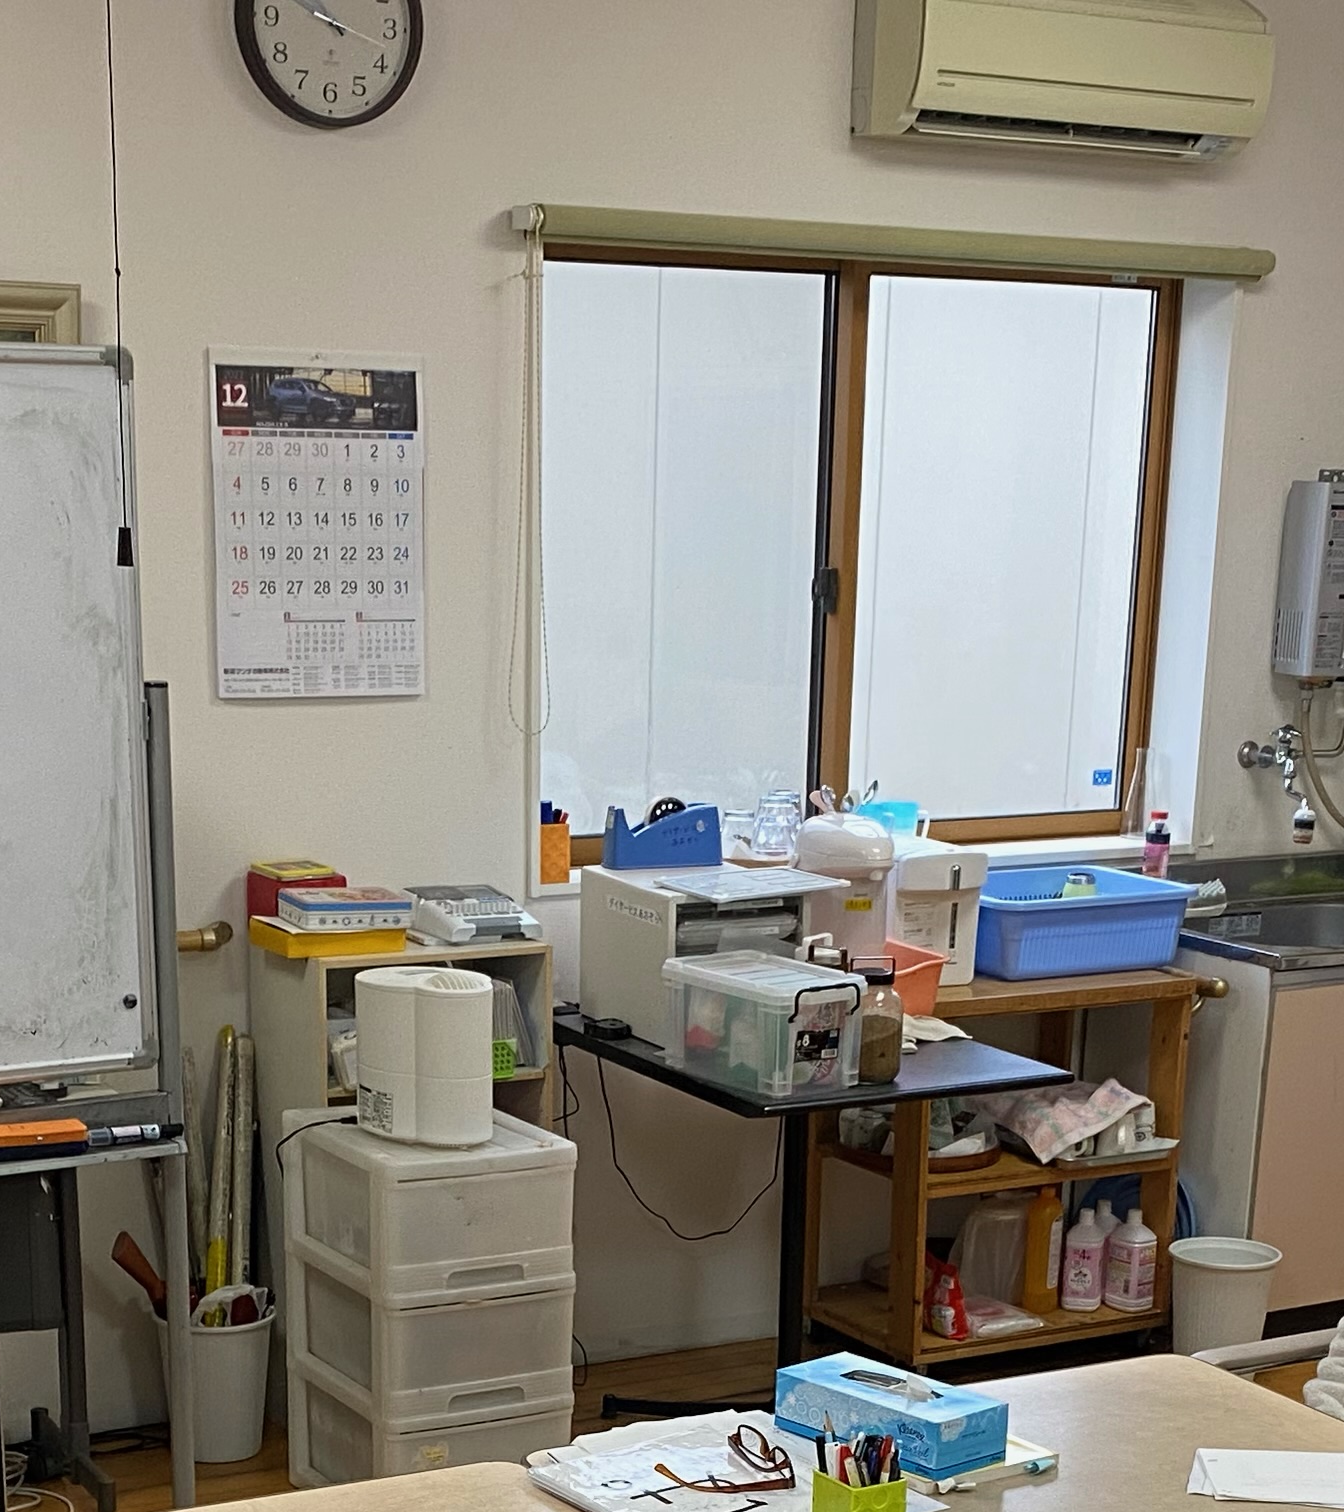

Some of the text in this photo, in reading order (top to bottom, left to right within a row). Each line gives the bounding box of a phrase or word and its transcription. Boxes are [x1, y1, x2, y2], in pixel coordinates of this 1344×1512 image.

[264, 5, 279, 27] 9
[383, 18, 397, 40] 3
[272, 41, 288, 64] 8
[373, 53, 388, 74] 4
[294, 69, 309, 90] 7
[352, 75, 367, 97] 5
[323, 82, 338, 103] 6
[222, 383, 249, 407] 12
[227, 441, 405, 459] 27 28 29 30 1 2 3
[233, 476, 409, 493] 4 5 6 7 8 9 10
[231, 511, 409, 527] 11 12 13 14 15 16 17
[232, 546, 409, 561] 18 19 20 21 22 23 24
[231, 581, 409, 595] 25 26 27 28 29 30 31
